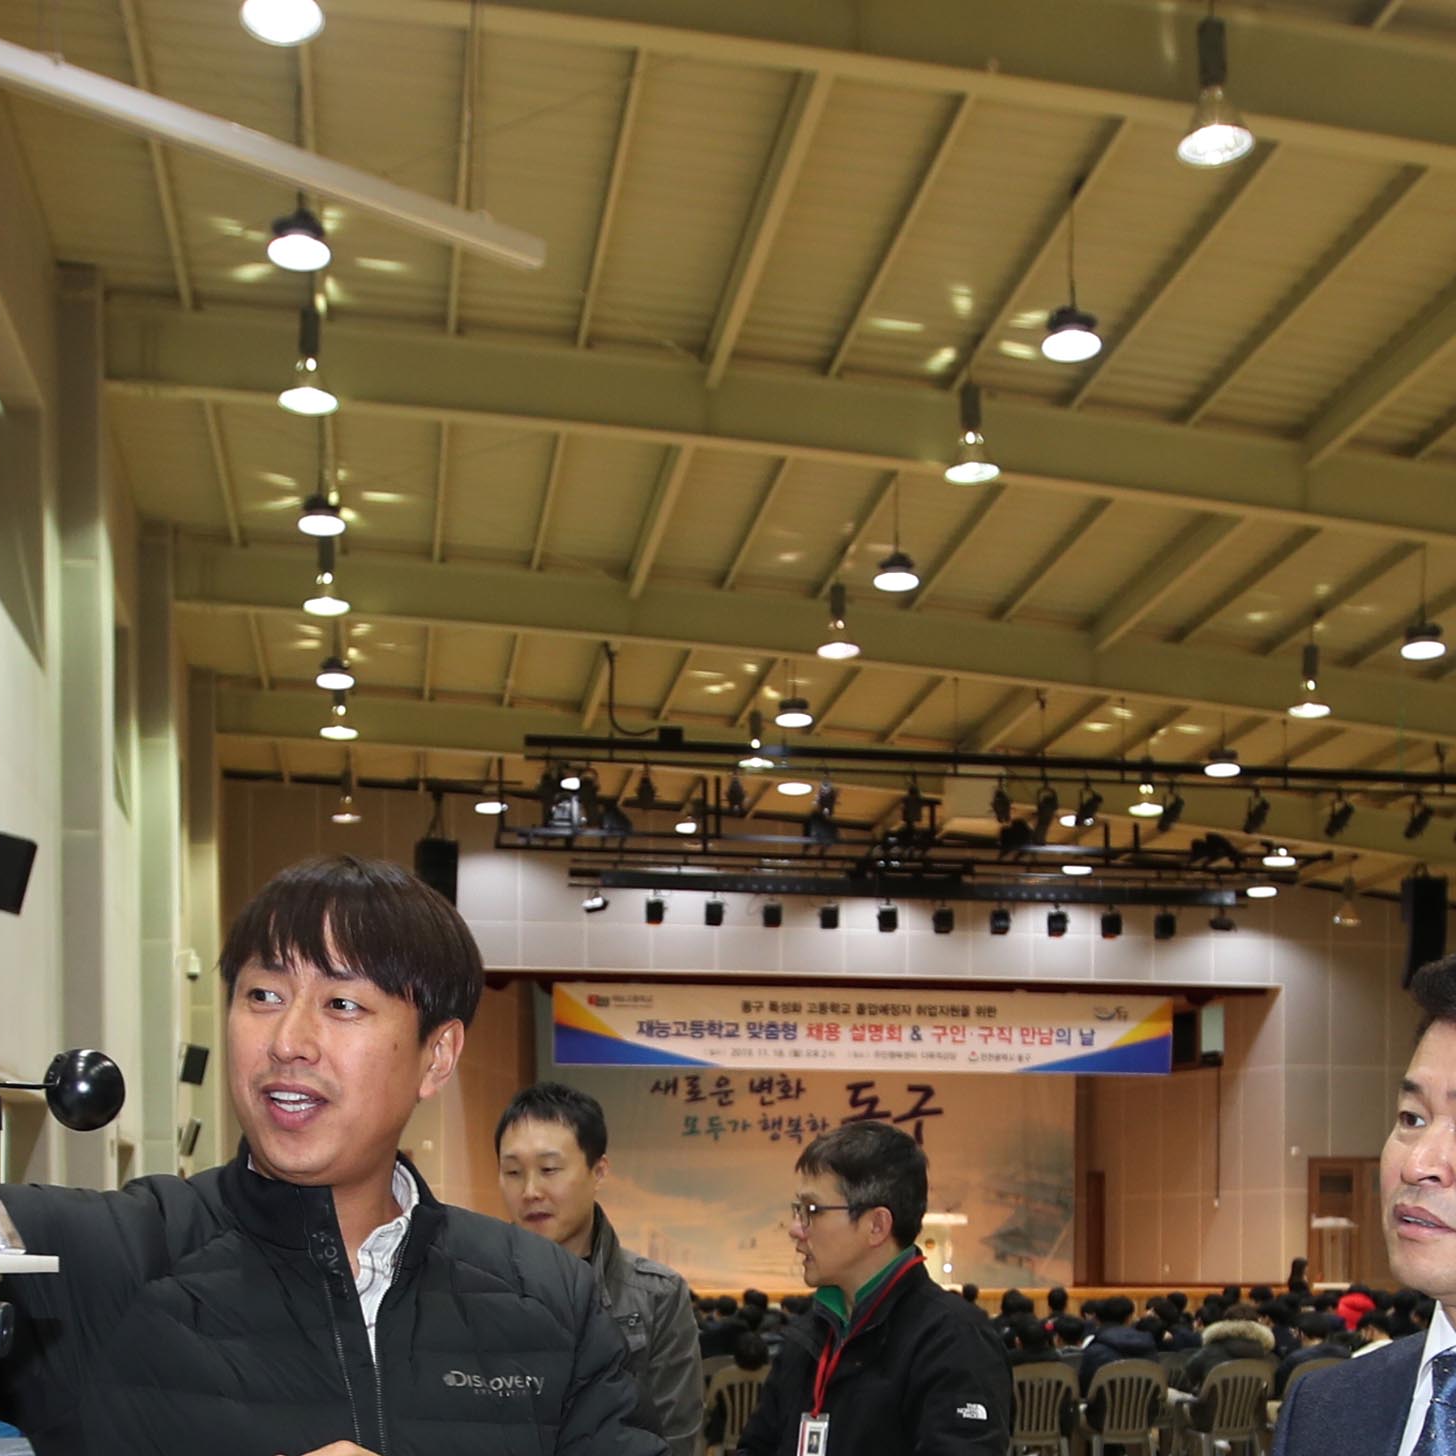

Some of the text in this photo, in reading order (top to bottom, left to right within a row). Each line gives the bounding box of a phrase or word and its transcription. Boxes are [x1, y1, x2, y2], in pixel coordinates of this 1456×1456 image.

[807, 1001, 851, 1016] 고등학교
[976, 1006, 997, 1019] 위한
[636, 1020, 741, 1040] 재능고등학교
[746, 1021, 798, 1041] 맞춤형
[806, 1022, 842, 1042] 채용
[849, 1023, 903, 1042] 설명회
[910, 1025, 923, 1042] &
[1020, 1026, 1073, 1046] 만남의
[1079, 1027, 1097, 1047] 날
[650, 1075, 735, 1108] 새로운
[749, 1073, 806, 1107] 변화
[681, 1114, 751, 1144] 모두가
